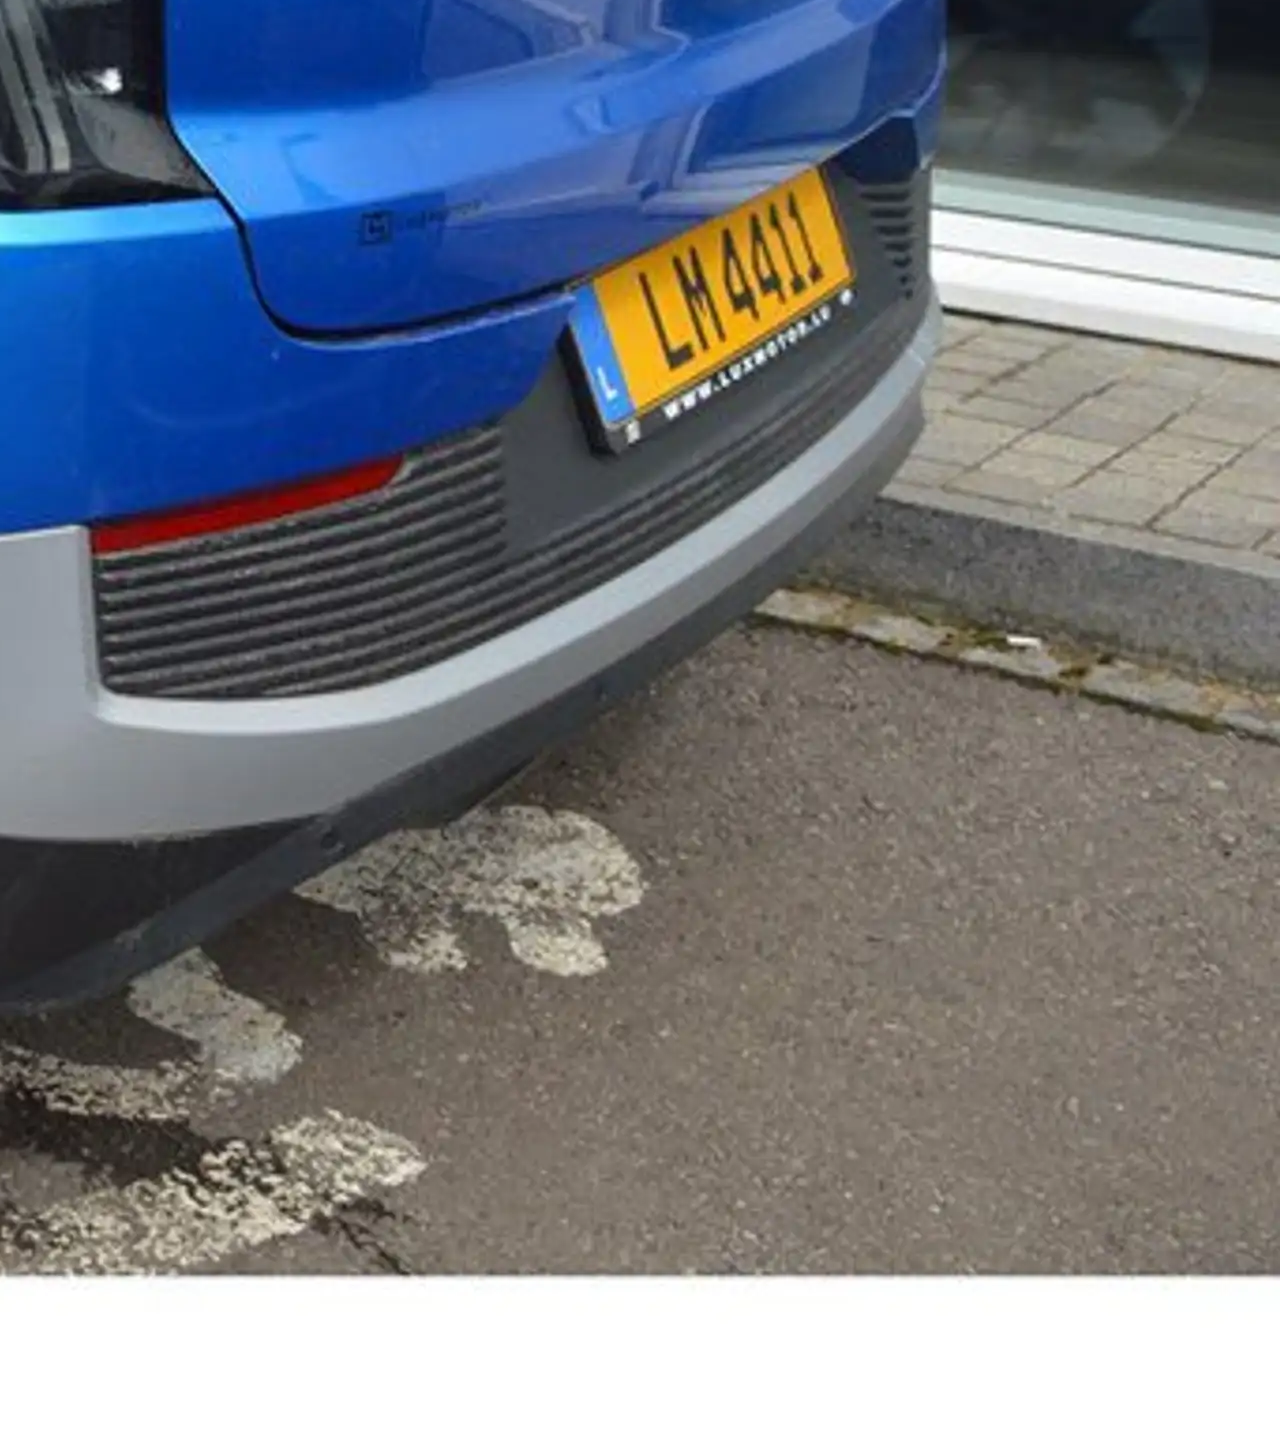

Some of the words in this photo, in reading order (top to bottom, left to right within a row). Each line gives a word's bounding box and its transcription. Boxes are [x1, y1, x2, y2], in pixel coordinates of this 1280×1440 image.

[720, 190, 825, 322] 4411
[596, 365, 618, 402] L
[662, 304, 832, 421] WWW.LUXMOTOR.LU
